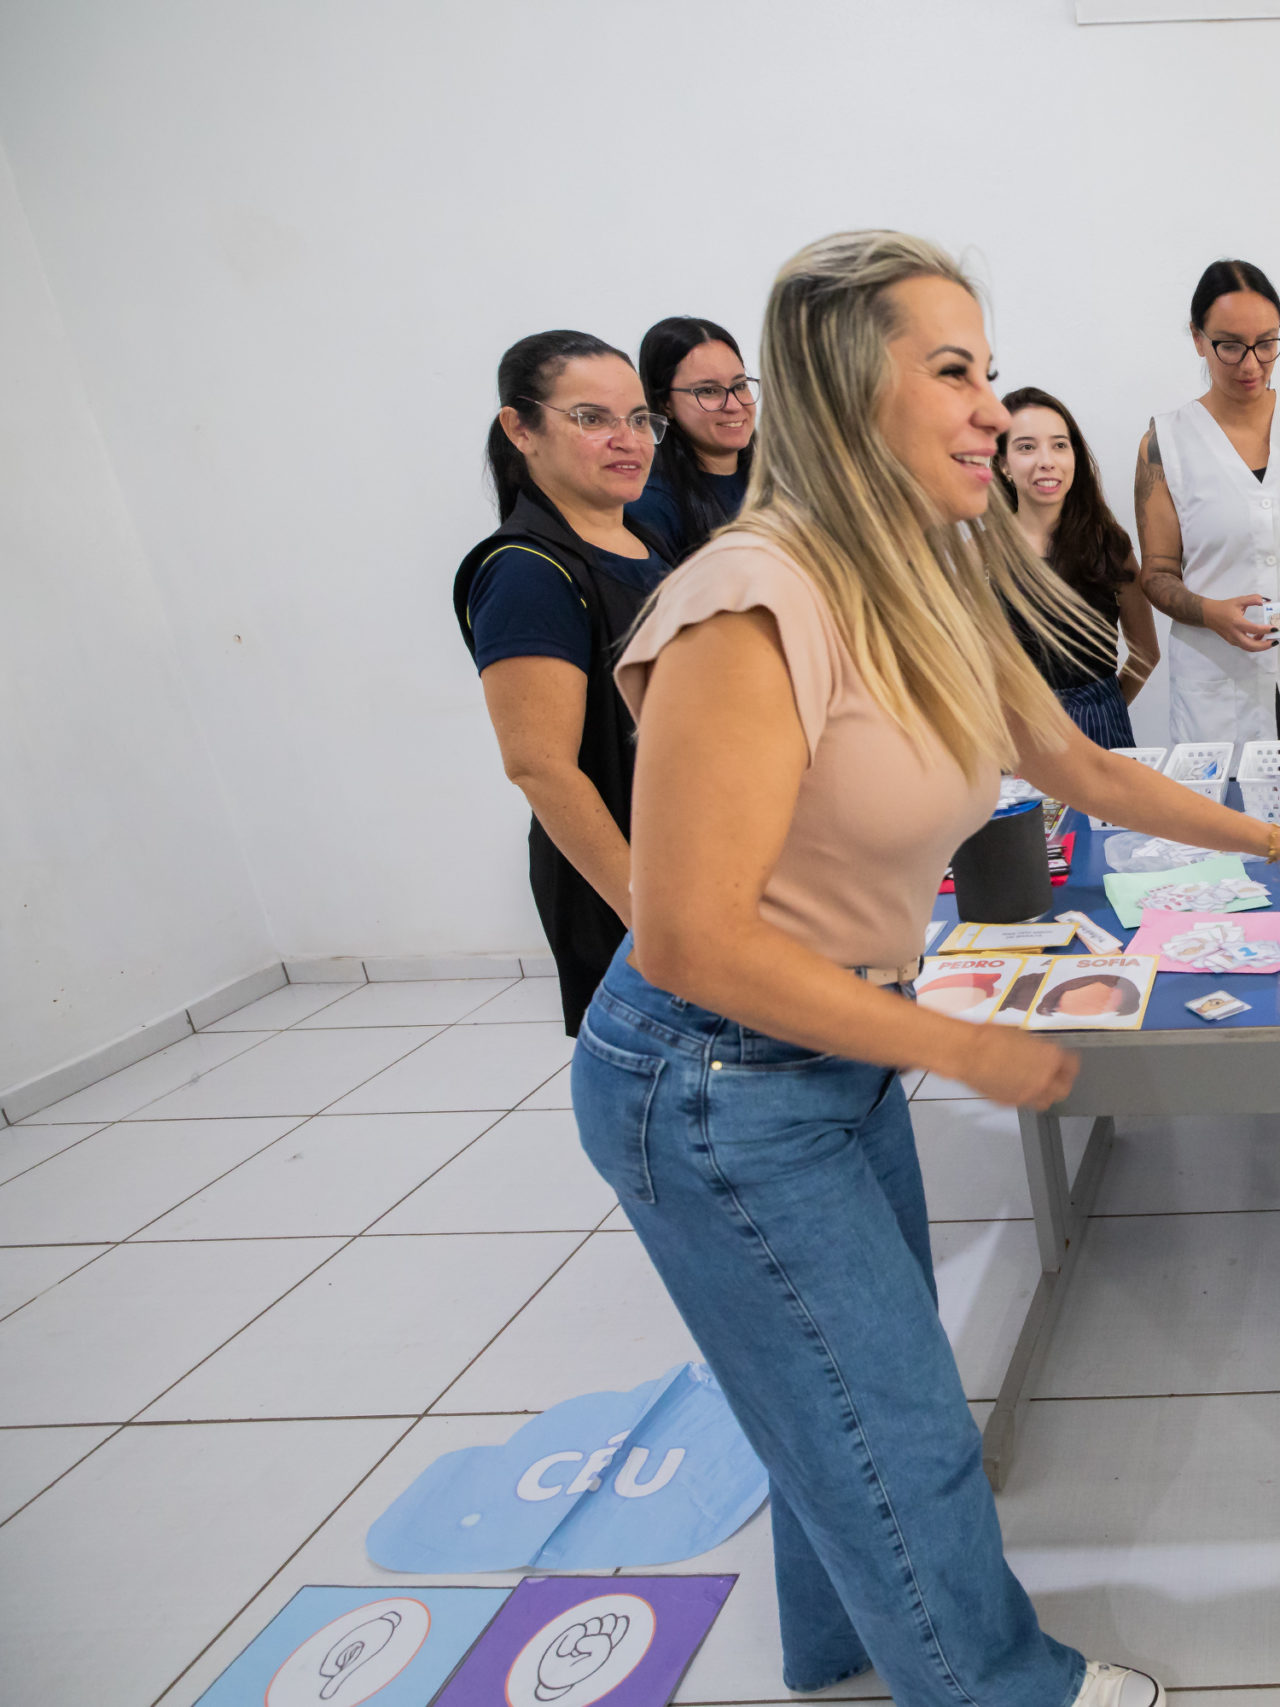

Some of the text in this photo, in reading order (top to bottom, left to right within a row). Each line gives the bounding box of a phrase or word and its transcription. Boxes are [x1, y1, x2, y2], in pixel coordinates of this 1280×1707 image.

[937, 959, 1006, 970] PEDRO
[1075, 958, 1141, 969] SOFIA
[516, 1429, 686, 1502] CÉU
